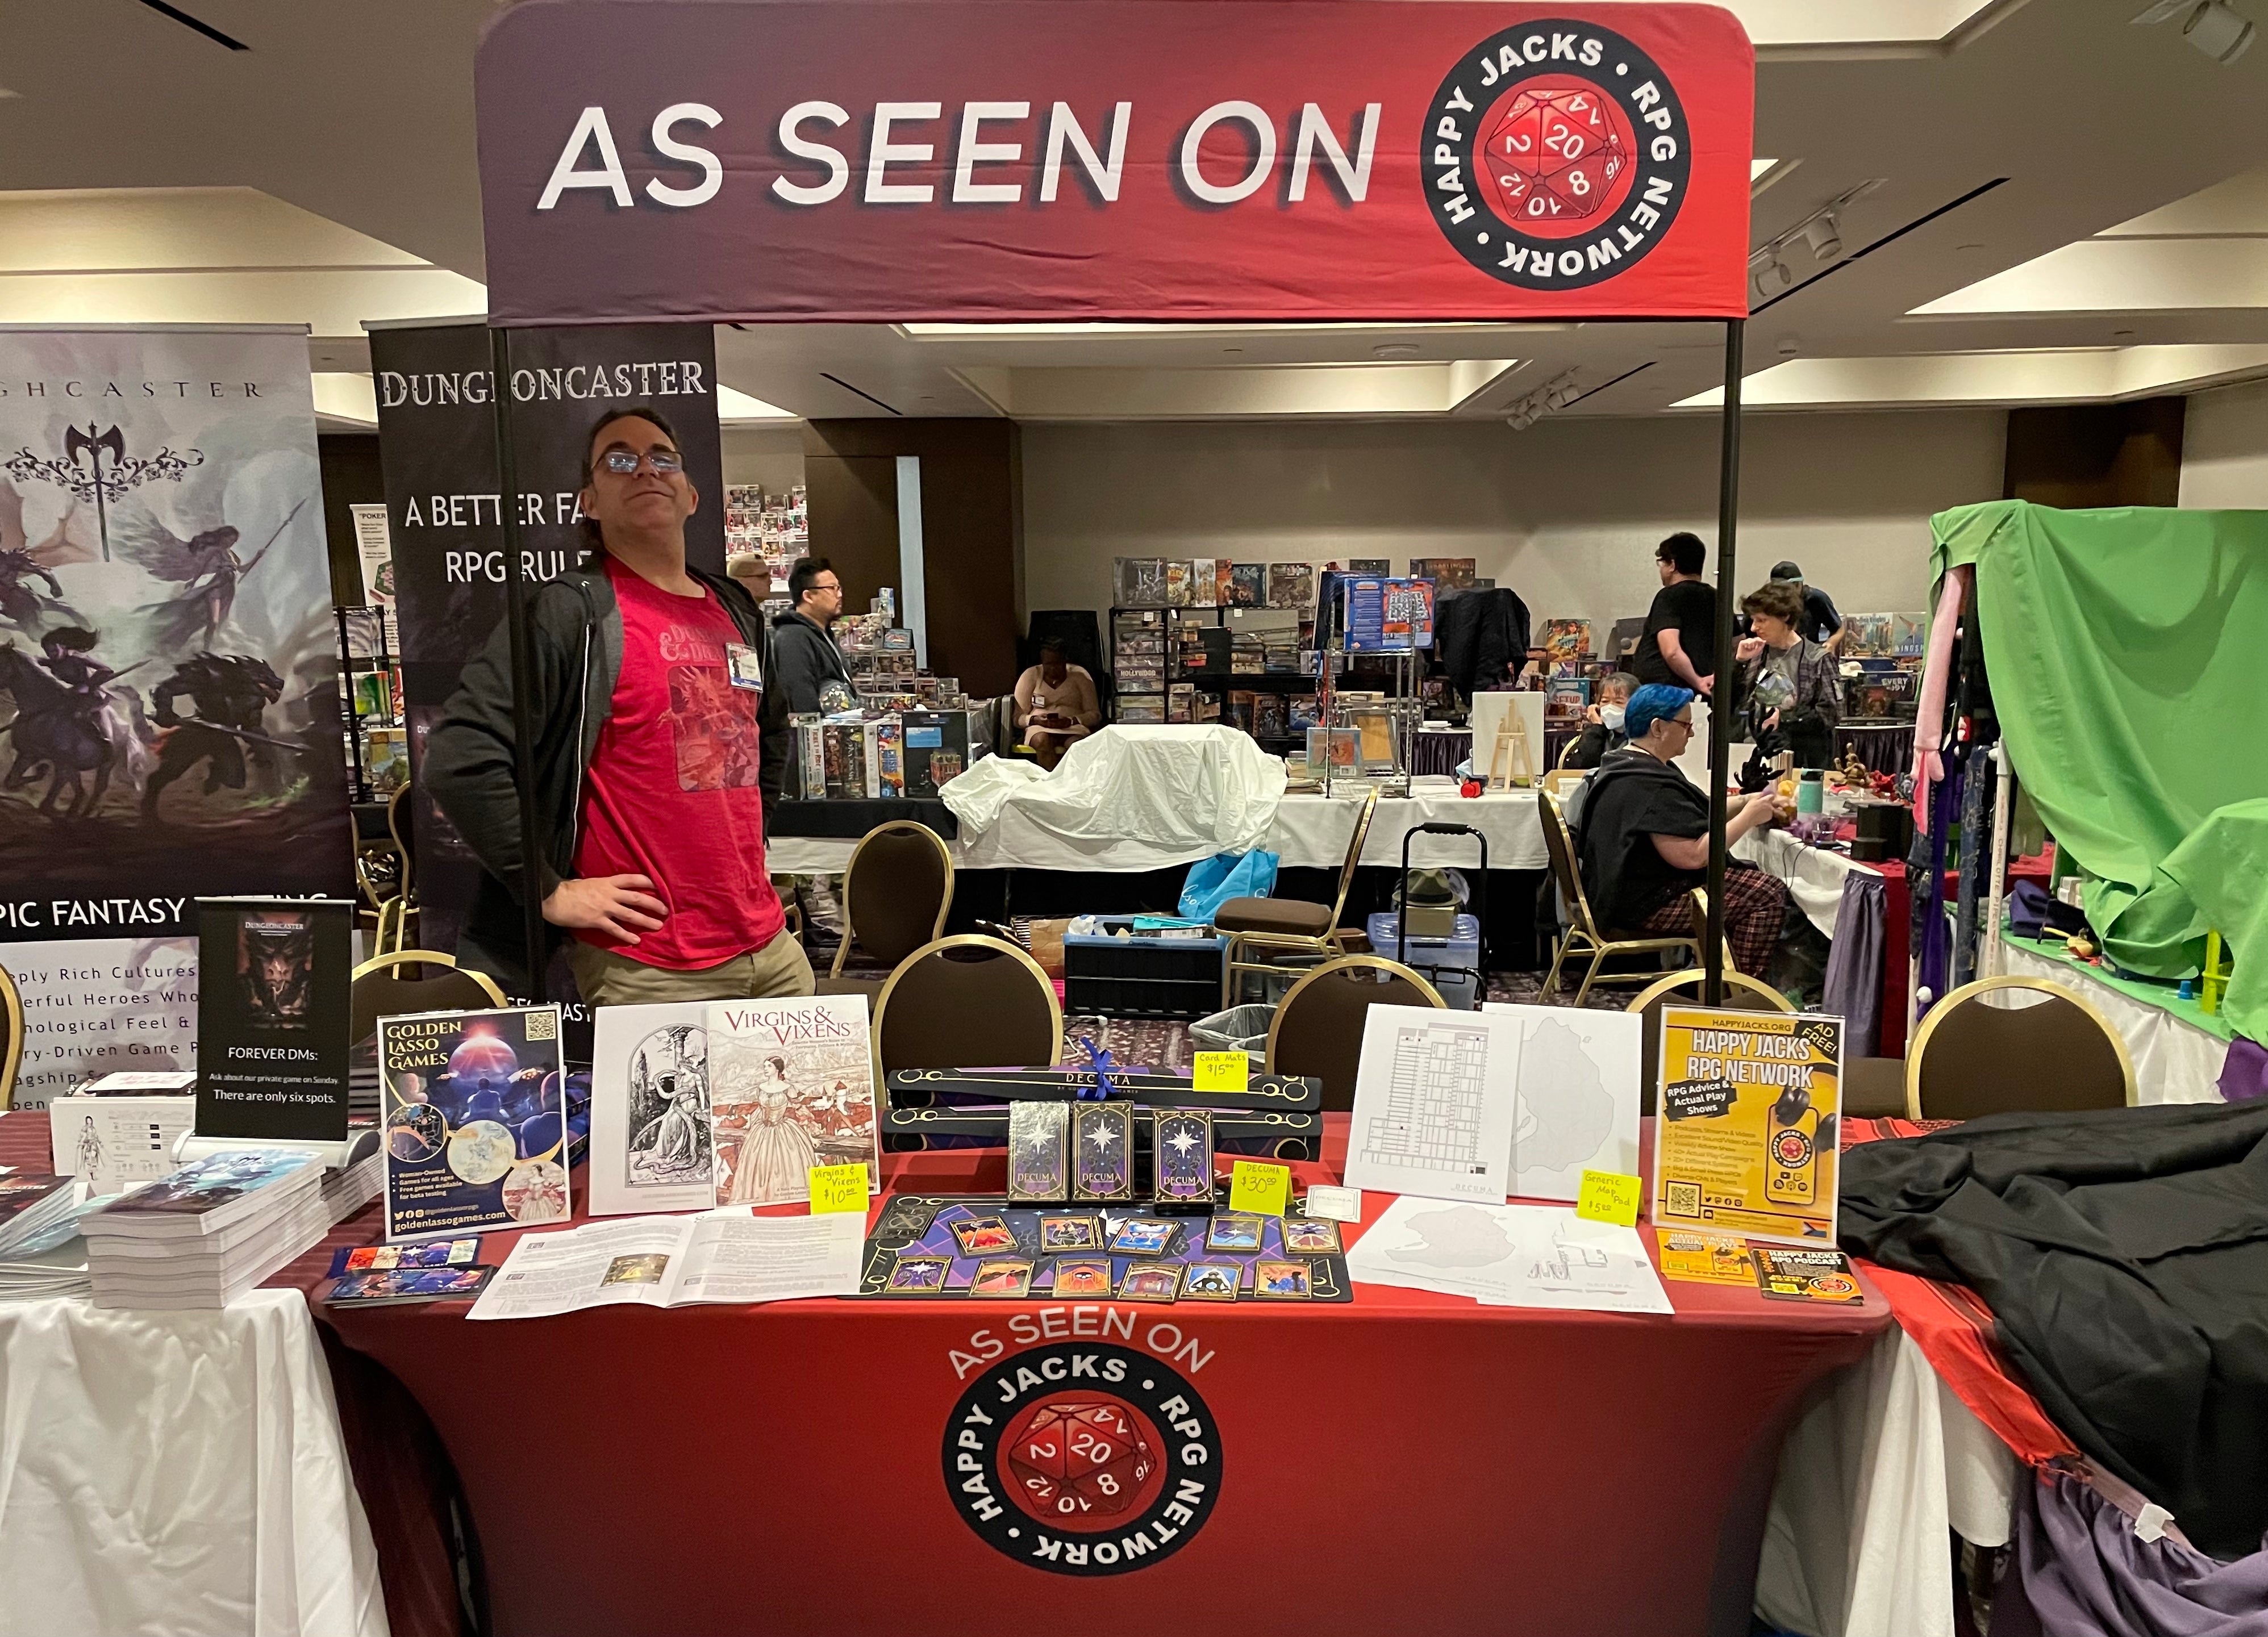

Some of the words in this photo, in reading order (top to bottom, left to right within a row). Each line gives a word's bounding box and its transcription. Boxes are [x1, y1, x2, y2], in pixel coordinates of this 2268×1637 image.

[1480, 33, 1604, 87] JACKS
[1631, 80, 1677, 162] RPG
[1545, 124, 1584, 158] 20
[536, 102, 723, 209] AS
[771, 100, 1132, 204] SEEN
[1180, 100, 1381, 203] ON
[1434, 85, 1474, 225] HAPPY
[1569, 170, 1590, 195] 8
[1498, 177, 1674, 278] NETWORK
[405, 496, 424, 527] A
[445, 551, 506, 582] RPG
[52, 897, 186, 926] FANTASY
[245, 922, 304, 930] DUNGEONCASTER
[60, 968, 101, 980] Rich
[112, 966, 195, 979] Cultures
[84, 993, 150, 1005] Heroes
[160, 991, 198, 1003] Who
[127, 1017, 166, 1029] Feel
[179, 1016, 190, 1028] &
[724, 1010, 811, 1032] VIRGINS
[814, 1005, 836, 1025] &
[1712, 1019, 1791, 1032] HAPPYJACKS.ORG
[387, 1021, 461, 1040] GOLDEN
[773, 1022, 851, 1046] VIXENS
[1813, 1022, 1835, 1038] AD
[128, 1043, 179, 1055] Game
[389, 1038, 439, 1056] LASSO
[1692, 1029, 1752, 1055] HAPPY
[1754, 1033, 1811, 1061] JACKS
[1802, 1027, 1837, 1054] FREE!
[228, 1047, 285, 1060] FOREVER
[288, 1049, 318, 1060] DMs:
[388, 1053, 448, 1071] GAMES
[1199, 1054, 1221, 1062] Card
[1225, 1053, 1246, 1062] Mats
[1066, 1073, 1130, 1085] DECMA
[1687, 1056, 1722, 1081] RPG
[1725, 1059, 1814, 1089] NETWORK
[213, 1089, 244, 1100] There
[265, 1092, 287, 1104] only
[289, 1092, 304, 1102] six
[305, 1094, 336, 1104] spots.
[1667, 1088, 1687, 1097] RPG
[1689, 1083, 1720, 1095] Advice
[1674, 1095, 1705, 1106] Actual
[1706, 1092, 1727, 1102] Play
[1686, 1105, 1718, 1115] Shows
[815, 1168, 845, 1181] Virgins
[1018, 1173, 1057, 1183] DECUMA
[1082, 1173, 1121, 1182] DECUMA
[1246, 1164, 1279, 1175] DECUMA
[832, 1177, 860, 1187] Vixens
[1164, 1176, 1204, 1185] DECUMA
[1585, 1172, 1621, 1186] Generic
[1596, 1185, 1616, 1197] Map
[1614, 1195, 1630, 1206] Pad
[394, 1211, 506, 1233] goldenlassogames.com
[948, 1330, 1004, 1380] AS
[1008, 1306, 1137, 1343] SEEN
[1147, 1323, 1215, 1373] ON
[997, 1355, 1128, 1403] JACKS
[1159, 1394, 1208, 1467] RPG
[1070, 1433, 1111, 1463] 20
[957, 1404, 1004, 1522] HAPPY
[1097, 1473, 1120, 1495] 8
[1033, 1479, 1205, 1565] NETWORK
